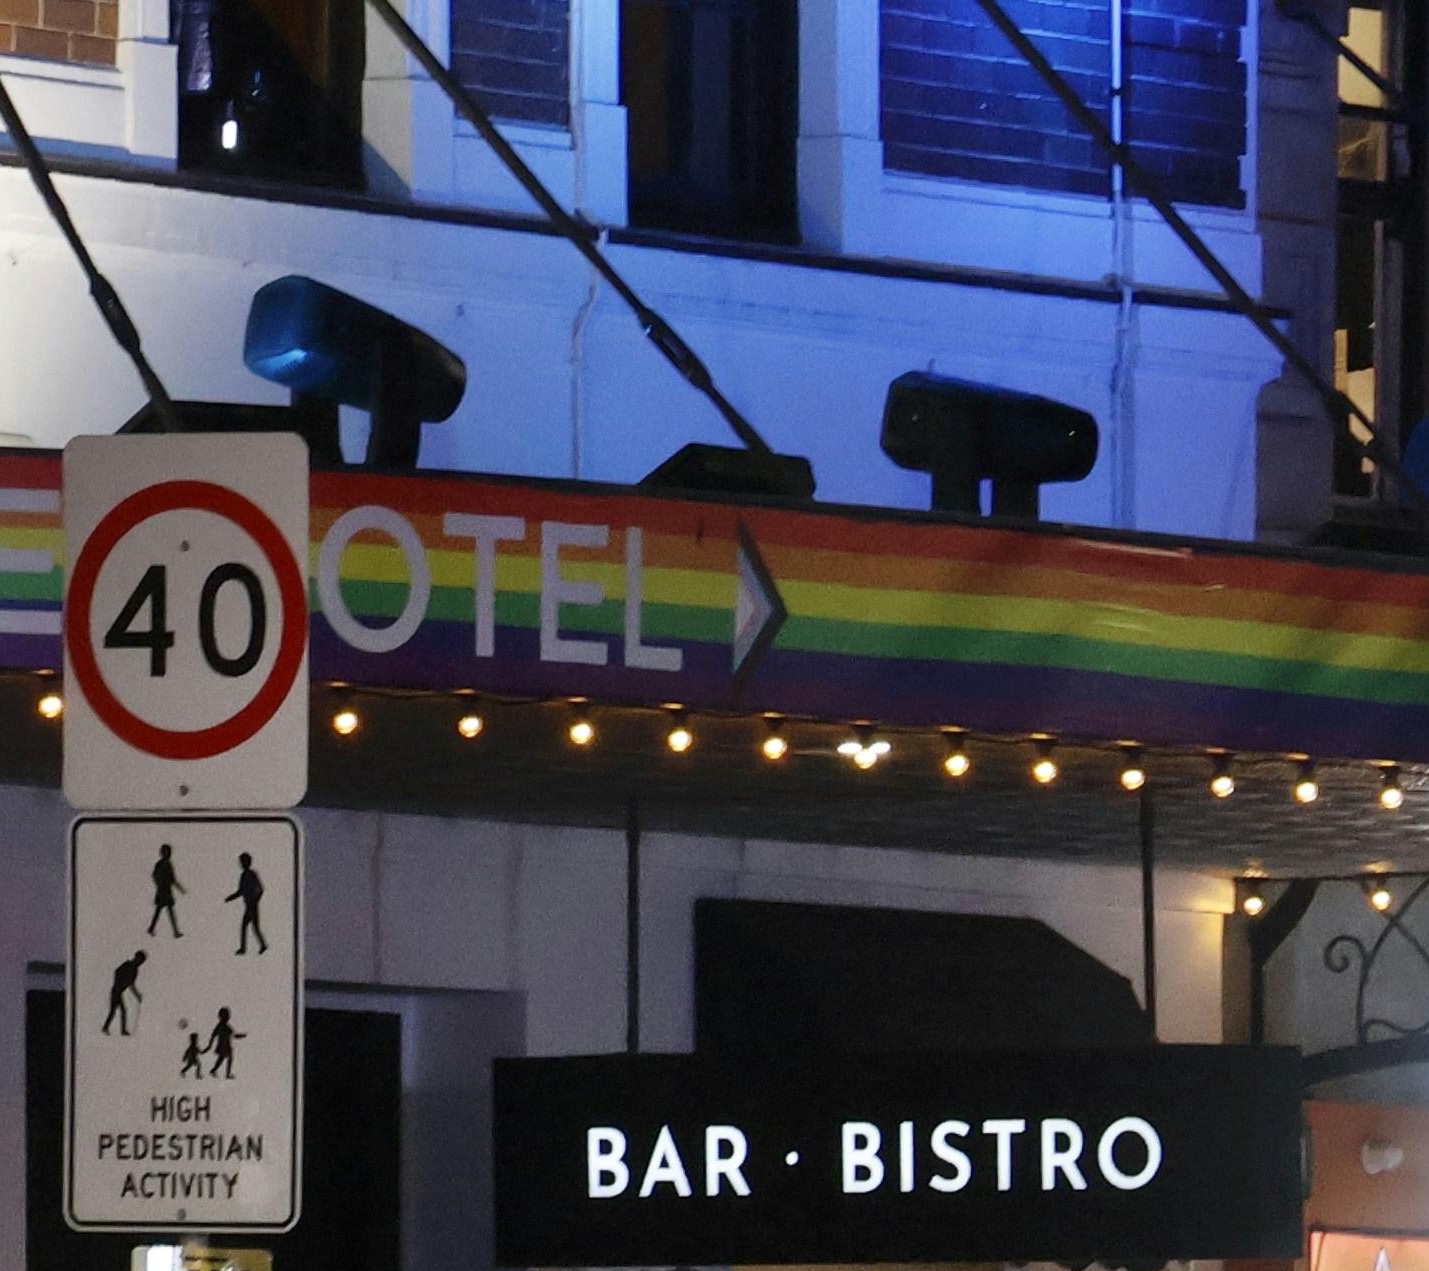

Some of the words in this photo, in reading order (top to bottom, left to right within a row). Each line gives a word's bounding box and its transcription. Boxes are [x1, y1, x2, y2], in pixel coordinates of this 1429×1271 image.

[318, 504, 684, 671] OTEL
[103, 561, 268, 678] 40
[150, 1095, 212, 1123] HIGH
[98, 1133, 264, 1162] PEDESTRIAN
[586, 1125, 752, 1200] BAR
[840, 1116, 1163, 1194] BISTRO
[120, 1171, 240, 1200] ACTIVITY
